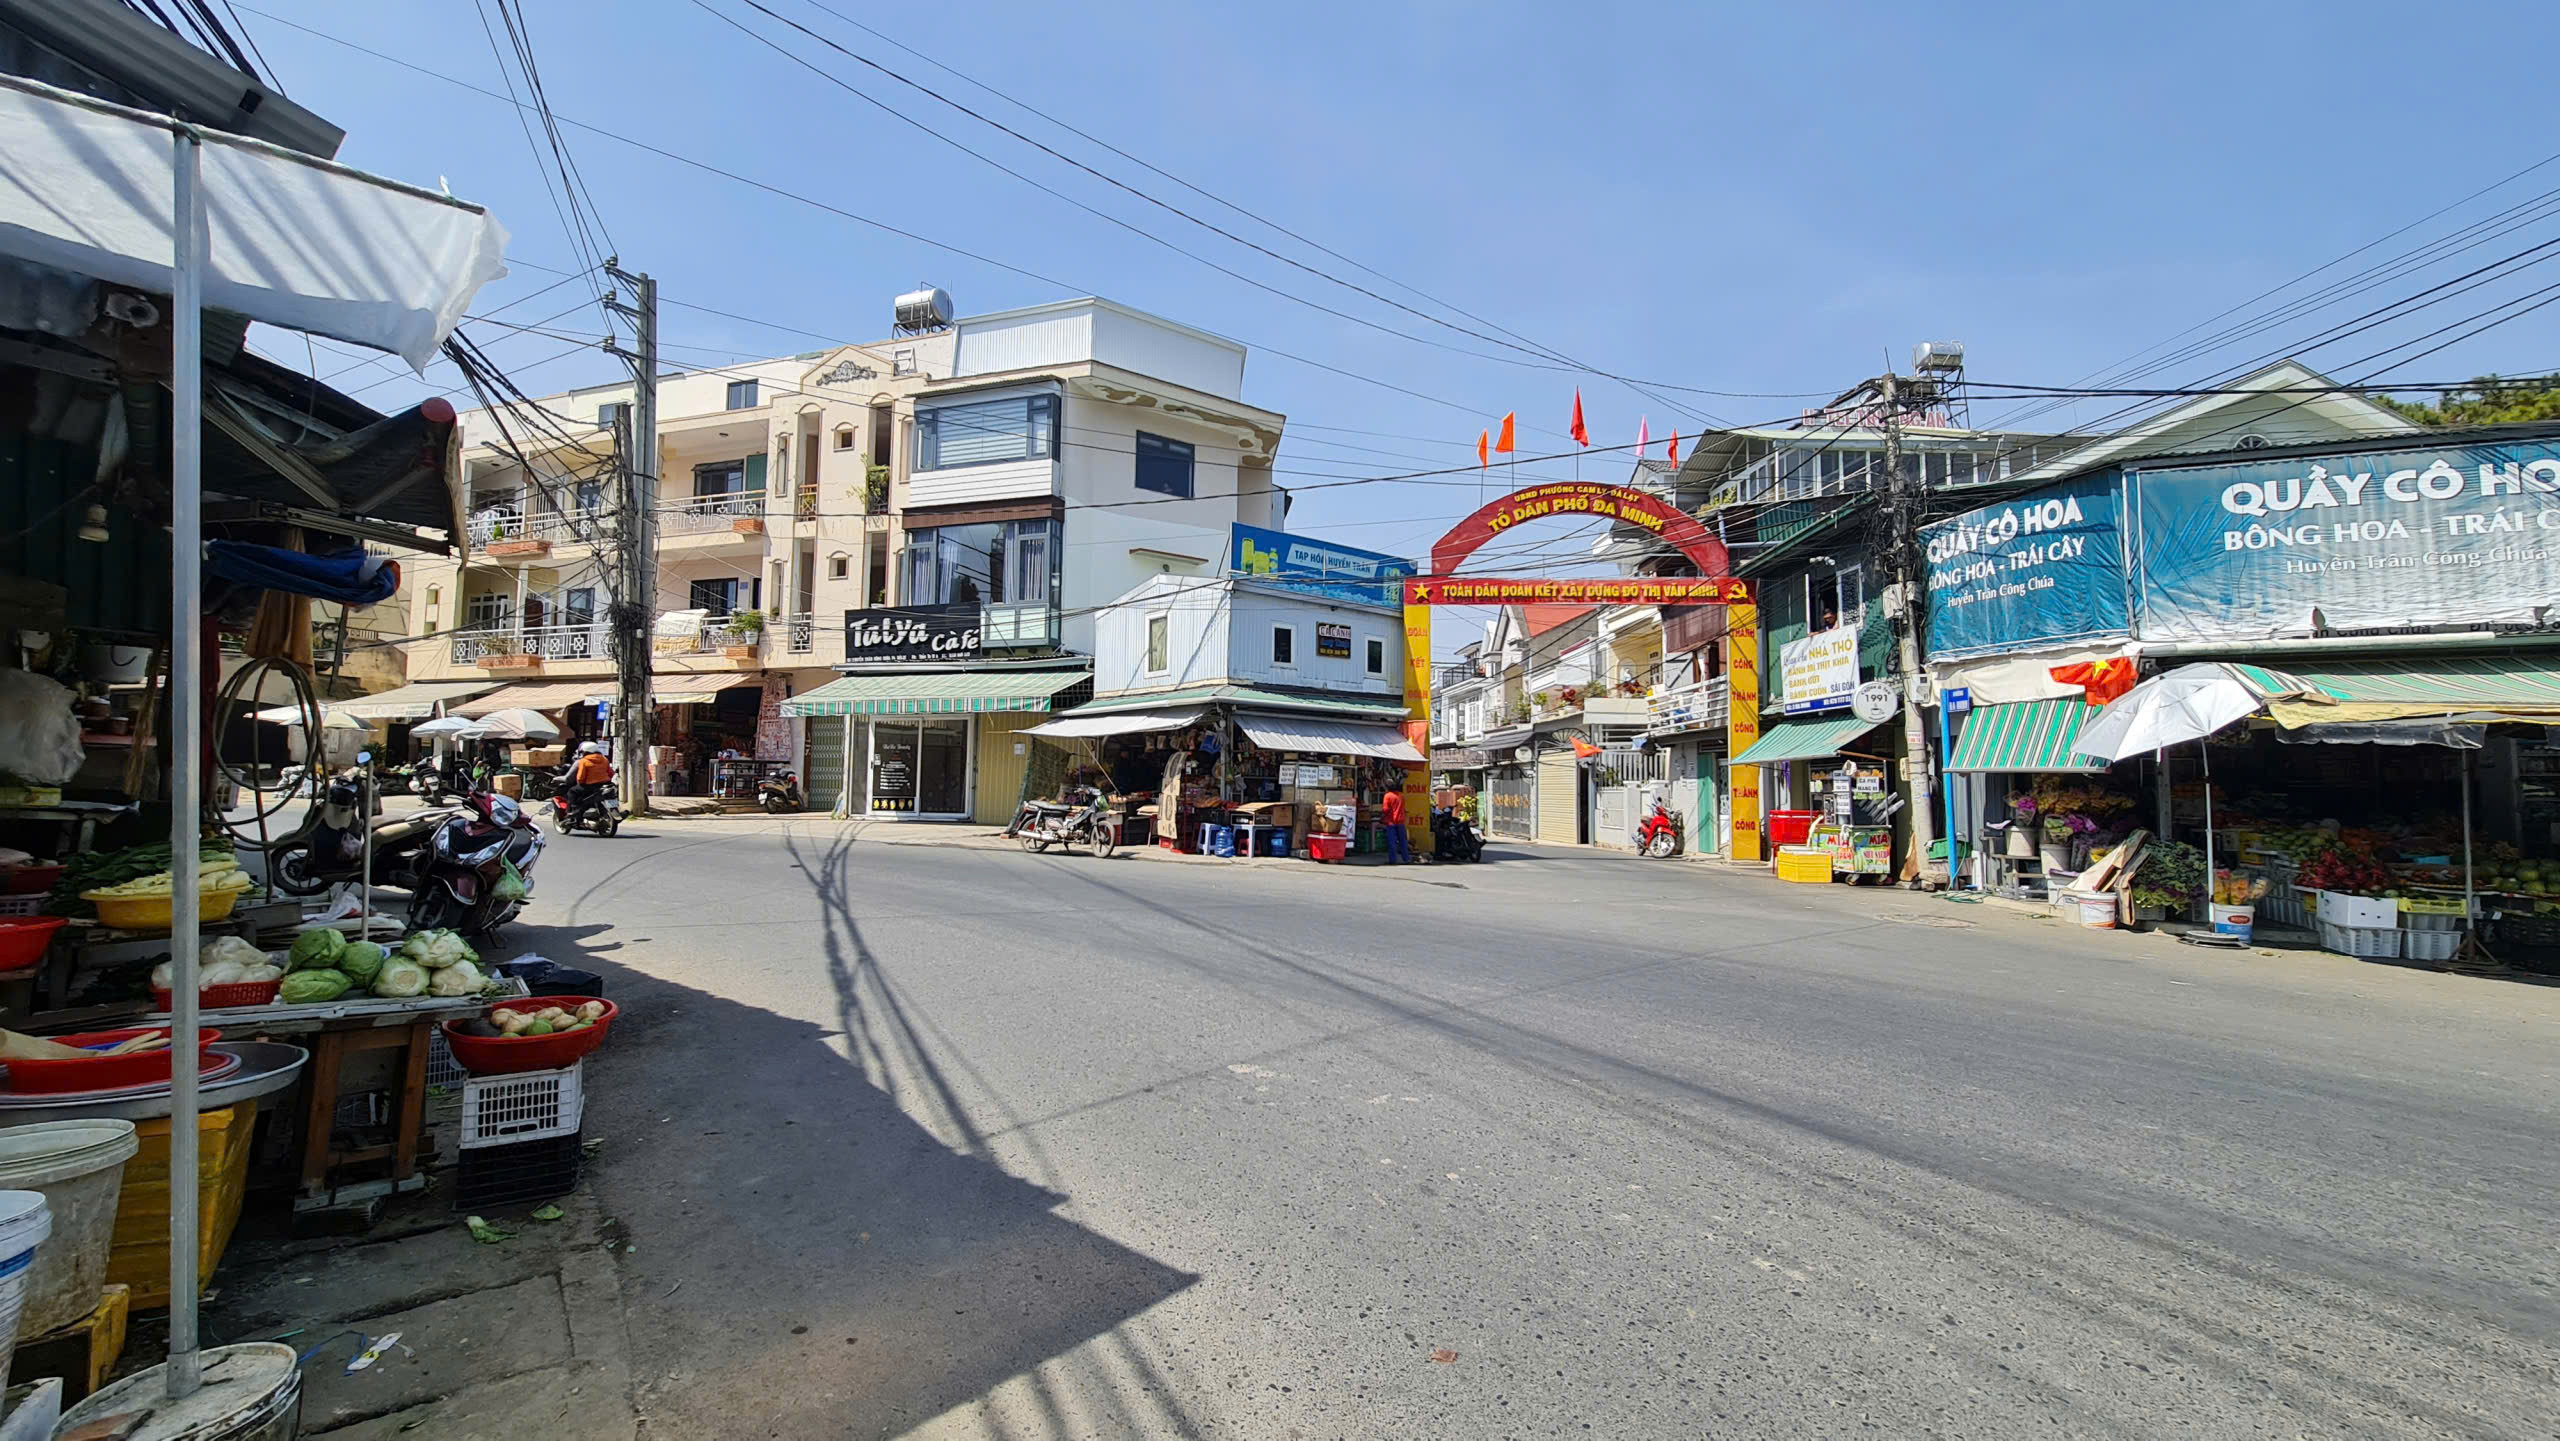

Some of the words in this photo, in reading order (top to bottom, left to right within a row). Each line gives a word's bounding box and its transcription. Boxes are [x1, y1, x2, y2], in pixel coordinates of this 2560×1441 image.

[2221, 464, 2373, 517] QUẦY
[2383, 458, 2465, 501] CÔ
[1488, 507, 1511, 533] TỔ
[1512, 500, 1549, 521] DÂN
[1552, 493, 1589, 511] PHỐ
[1592, 499, 1616, 515] ĐA
[1620, 505, 1664, 532] MINH
[1986, 507, 2019, 545] CÔ
[2024, 494, 2083, 535] HOA
[2224, 524, 2321, 551] BÔNG
[2334, 518, 2410, 543] HOA
[2442, 505, 2525, 536] TRÁI
[1929, 568, 1963, 591] BÔNG
[1965, 559, 1996, 582] HOA
[2008, 543, 2044, 571] TRÁI
[2048, 535, 2086, 561] CÂY
[2287, 553, 2356, 576] Huyền
[2423, 547, 2482, 568] Công
[2489, 545, 2548, 562] Chúa
[1442, 582, 1473, 597] TOÀN
[1476, 582, 1499, 597] DÂN
[1501, 582, 1533, 597] ĐOÀN
[1535, 581, 1558, 597] KẾT
[1561, 582, 1583, 597] XÂY
[1622, 583, 1639, 597] ĐÔ
[1643, 585, 1661, 600] THỊ
[1664, 582, 1686, 597] VĂN
[1999, 580, 2026, 597] Công
[2028, 574, 2054, 591] Chúa
[1733, 658, 1753, 670] CÔNG
[1865, 694, 1888, 702] 1991
[1734, 722, 1754, 733] CÔNG
[1735, 818, 1756, 831] CÔNG
